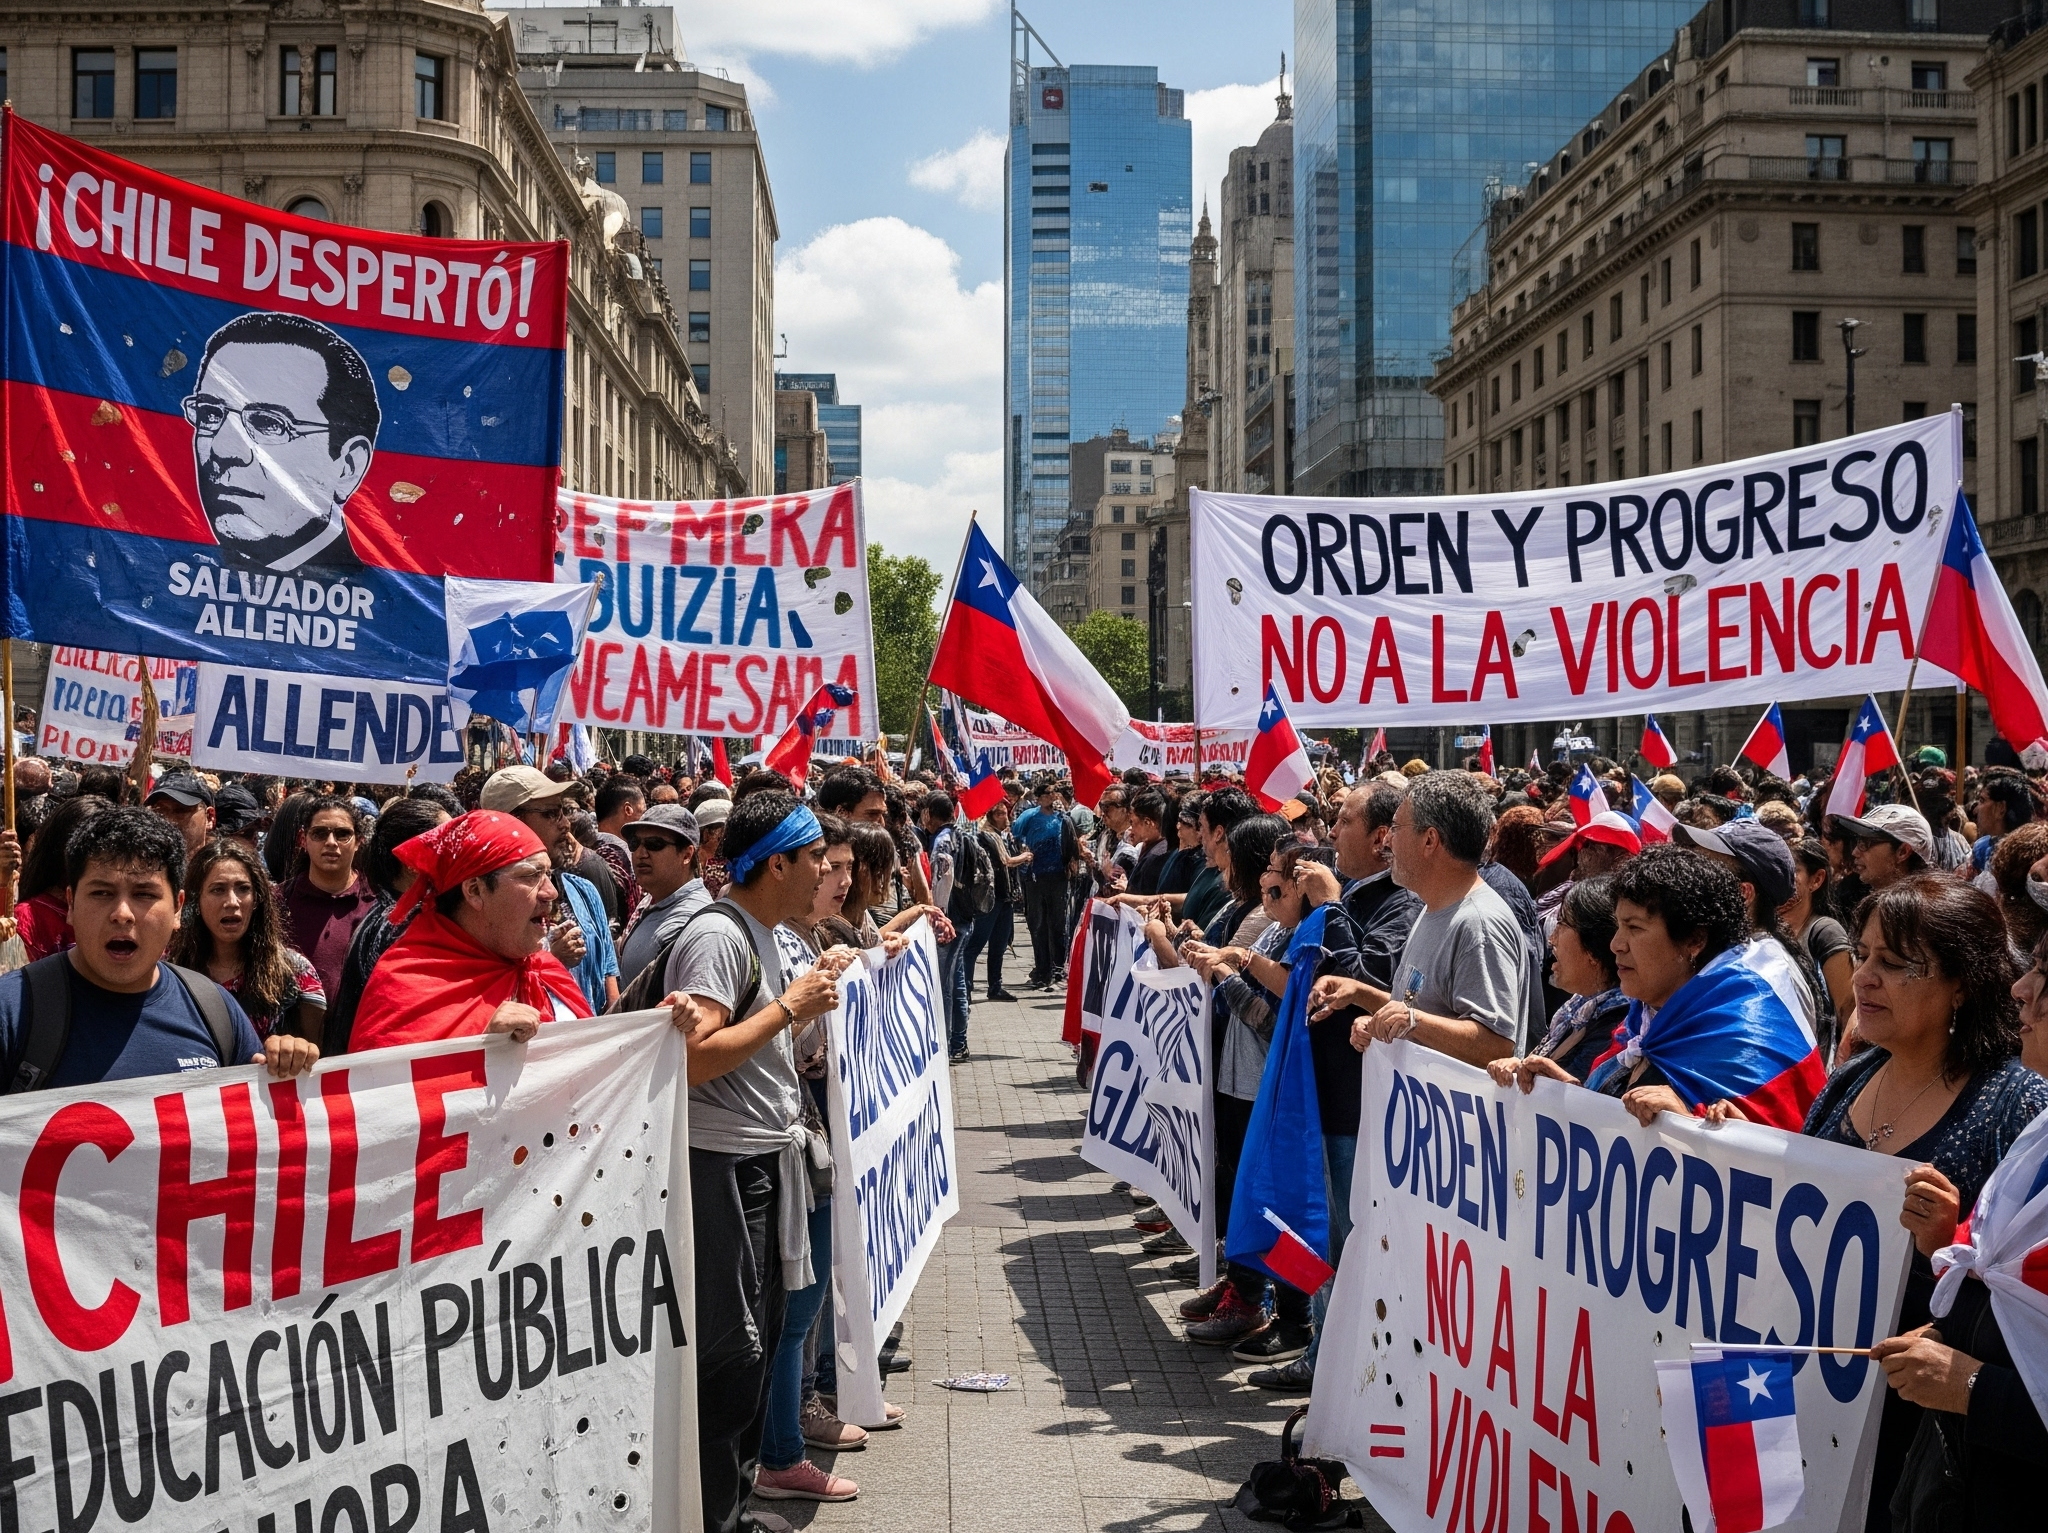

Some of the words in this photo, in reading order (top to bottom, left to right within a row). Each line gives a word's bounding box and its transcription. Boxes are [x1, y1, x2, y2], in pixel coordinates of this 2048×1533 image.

[35, 163, 221, 283] ¡CHILE
[243, 223, 536, 338] DESPERTÓ!
[1261, 511, 1473, 596] ORDEN
[1491, 506, 1544, 588] Y
[1566, 440, 1928, 583] PROGRESO
[194, 603, 358, 650] ALLENDE
[1261, 614, 1346, 704] NO
[1359, 616, 1409, 705] A
[1432, 610, 1520, 703] LA
[1550, 562, 1914, 695] VIOLENCIA
[207, 674, 465, 764] ALLENDE
[1385, 1068, 1507, 1241] ORDEN
[1535, 1113, 1880, 1403] PROGRESO
[0, 1293, 397, 1533] EDUCACIÓN
[421, 1229, 688, 1418] PÚBLICA
[1426, 1223, 1475, 1368] NO
[1487, 1265, 1518, 1410] A
[1533, 1287, 1600, 1467] LA
